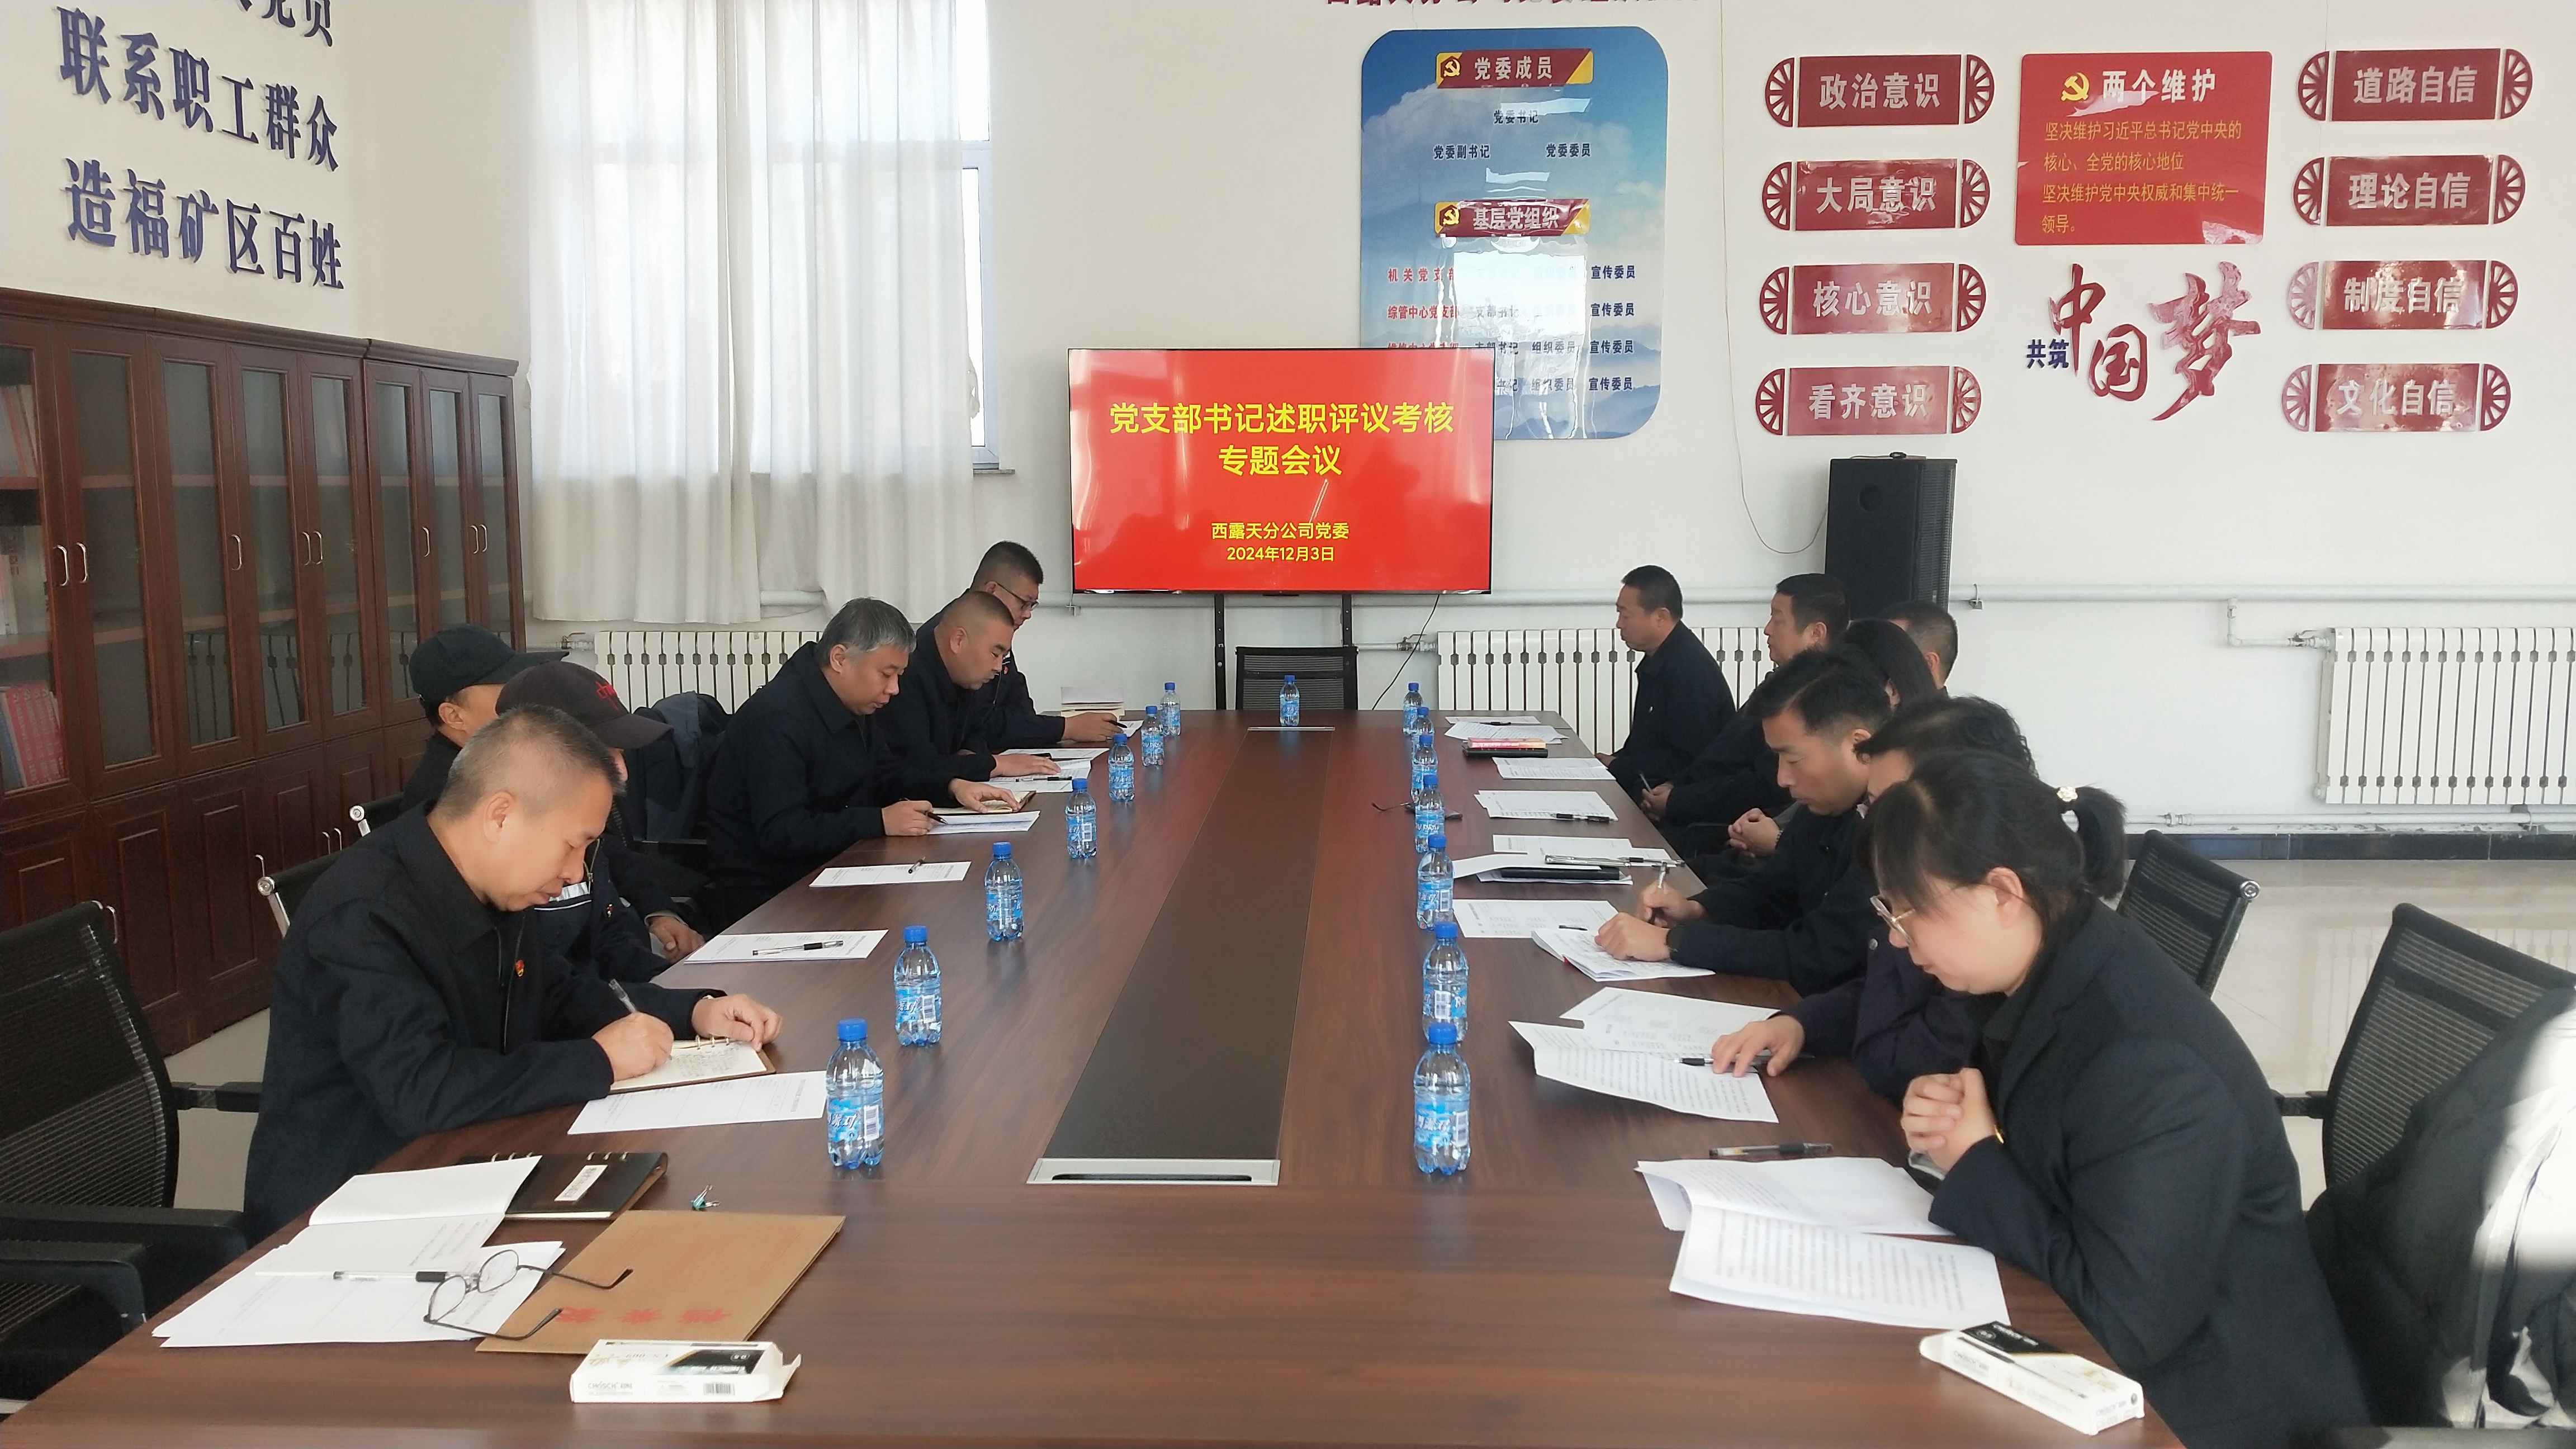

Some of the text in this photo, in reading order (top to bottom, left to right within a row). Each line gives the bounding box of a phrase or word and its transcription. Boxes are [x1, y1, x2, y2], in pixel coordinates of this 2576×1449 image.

[1474, 56, 1552, 80] 党委成员
[57, 6, 339, 172] 联系职工群众
[1819, 72, 1940, 110] 政治意识
[2102, 68, 2216, 103] 两个维护
[2354, 65, 2478, 104] 道路自信
[1494, 109, 1538, 124] 党委书记
[2045, 120, 2241, 141] 坚决维护习近平总书记党中央的
[1433, 143, 1591, 159] 党委副书记 党委委员
[2043, 151, 2184, 172] 核心、全党的核心地位
[1816, 176, 1936, 214] 大局意识
[2042, 182, 2239, 203] 坚决维护党中央权威和集中统一
[2348, 172, 2471, 210] 理论自信
[63, 158, 344, 290] 造福矿区百姓
[1473, 206, 1560, 230] 基层党组织
[2042, 214, 2076, 234] 领导。
[1591, 264, 1636, 279] 宣传委员
[1590, 302, 1635, 317] 宣传委员
[1812, 281, 1932, 318] 核心意识
[2343, 276, 2464, 314] 制度自信
[1532, 341, 1576, 355] 组织委员
[1589, 340, 1633, 354] 宣传委员
[2025, 338, 2070, 370] 共筑
[2048, 261, 2261, 422] 中国梦
[1588, 377, 1632, 391] 宣传委员
[2337, 378, 2457, 416] 文化自信
[1808, 383, 1928, 419] 看齐意识
[1109, 401, 1455, 434] 党支部书记述职评议考核
[1218, 445, 1342, 476] 专题会议
[1211, 522, 1349, 540] 西露天分公司党委
[1227, 546, 1335, 562] 2024年12月3日
